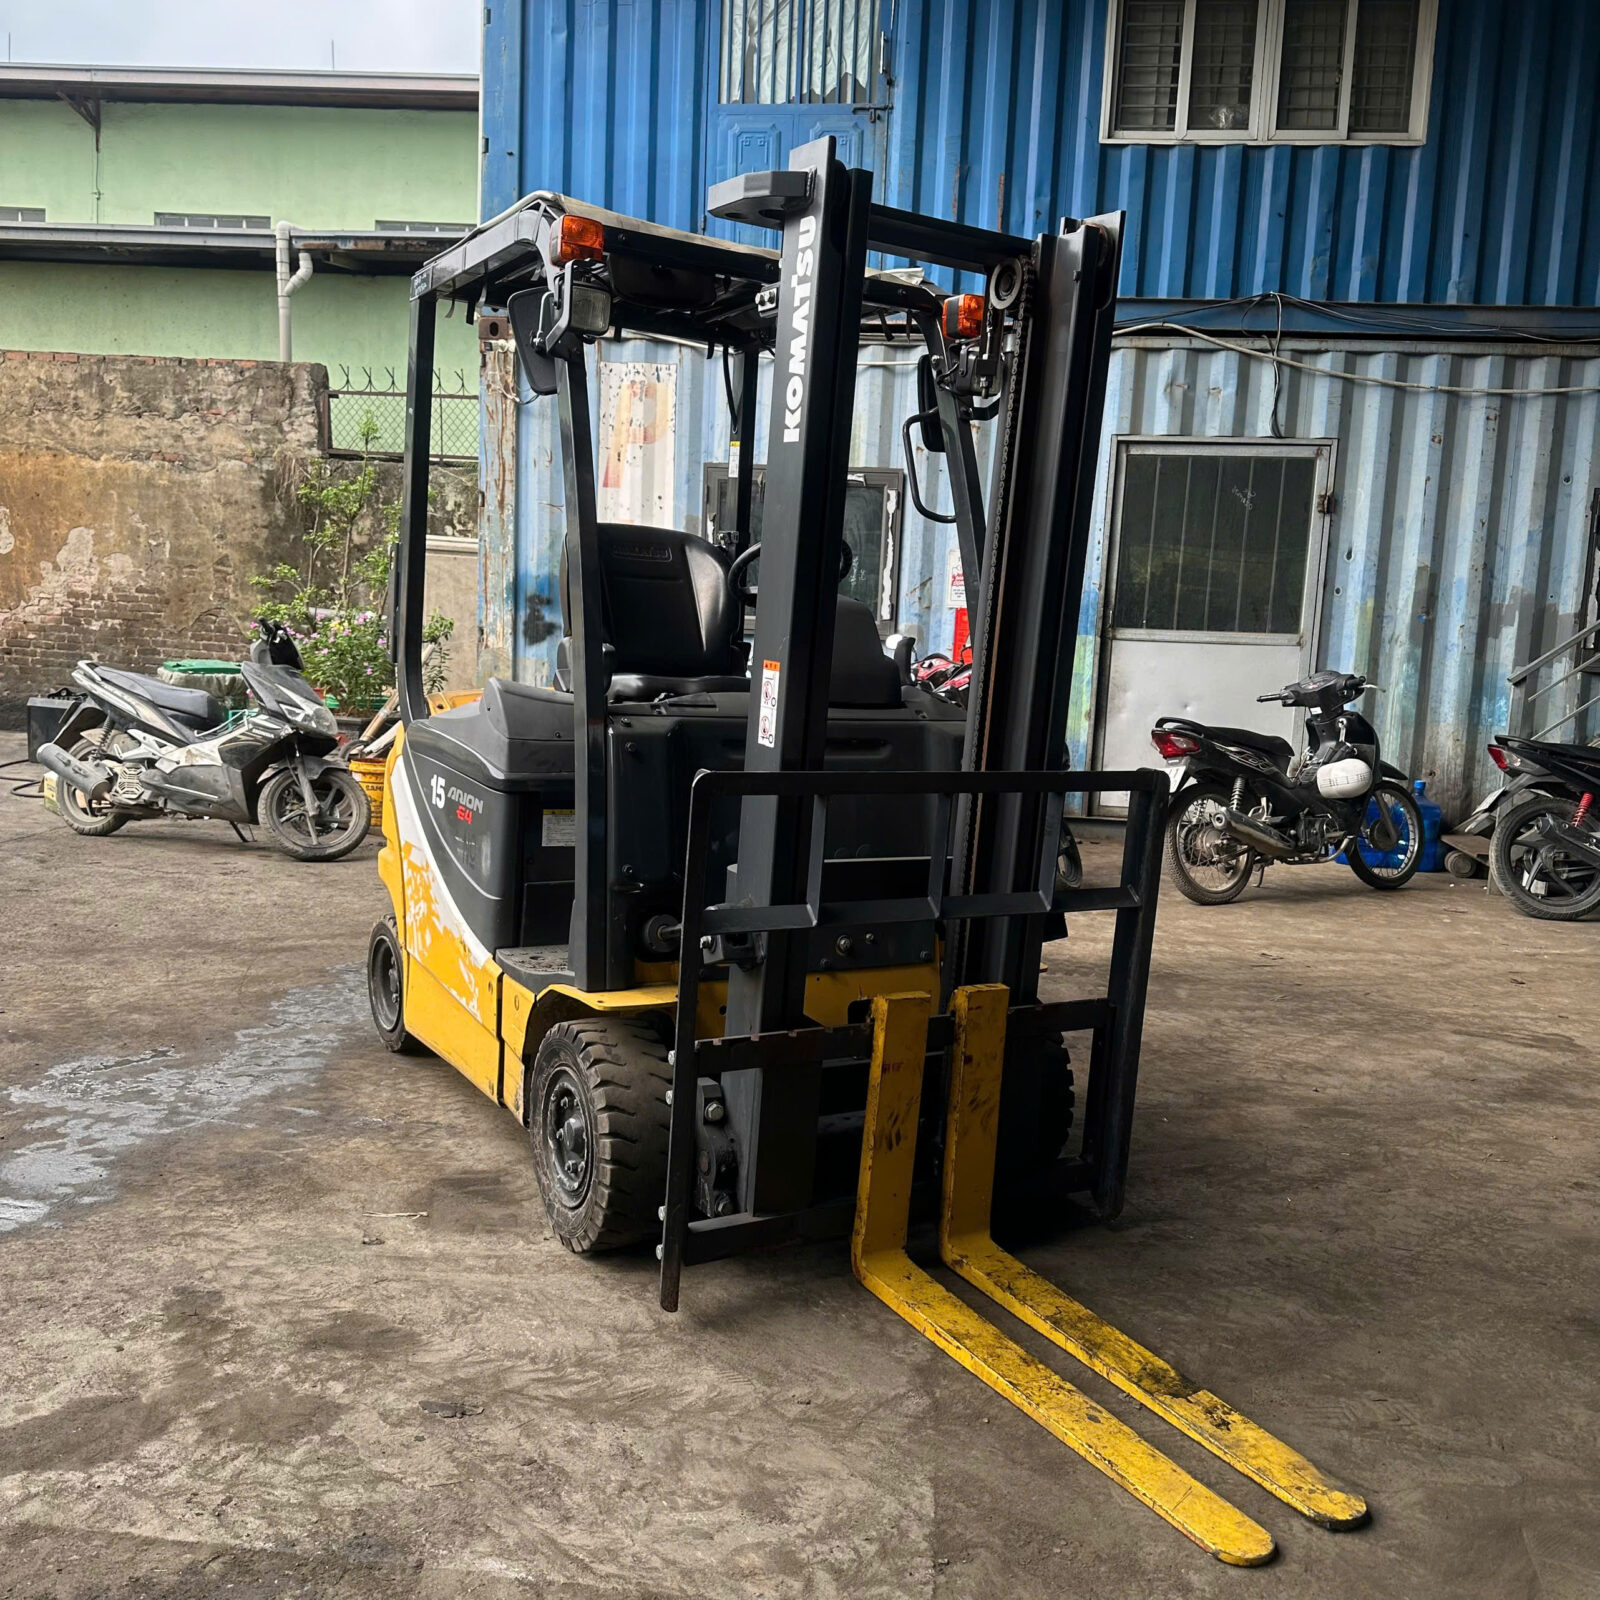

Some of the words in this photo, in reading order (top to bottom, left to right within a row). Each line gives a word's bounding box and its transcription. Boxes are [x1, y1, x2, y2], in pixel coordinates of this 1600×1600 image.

[783, 215, 817, 443] KOMATSU
[430, 774, 446, 809] 15
[456, 805, 473, 825] E4
